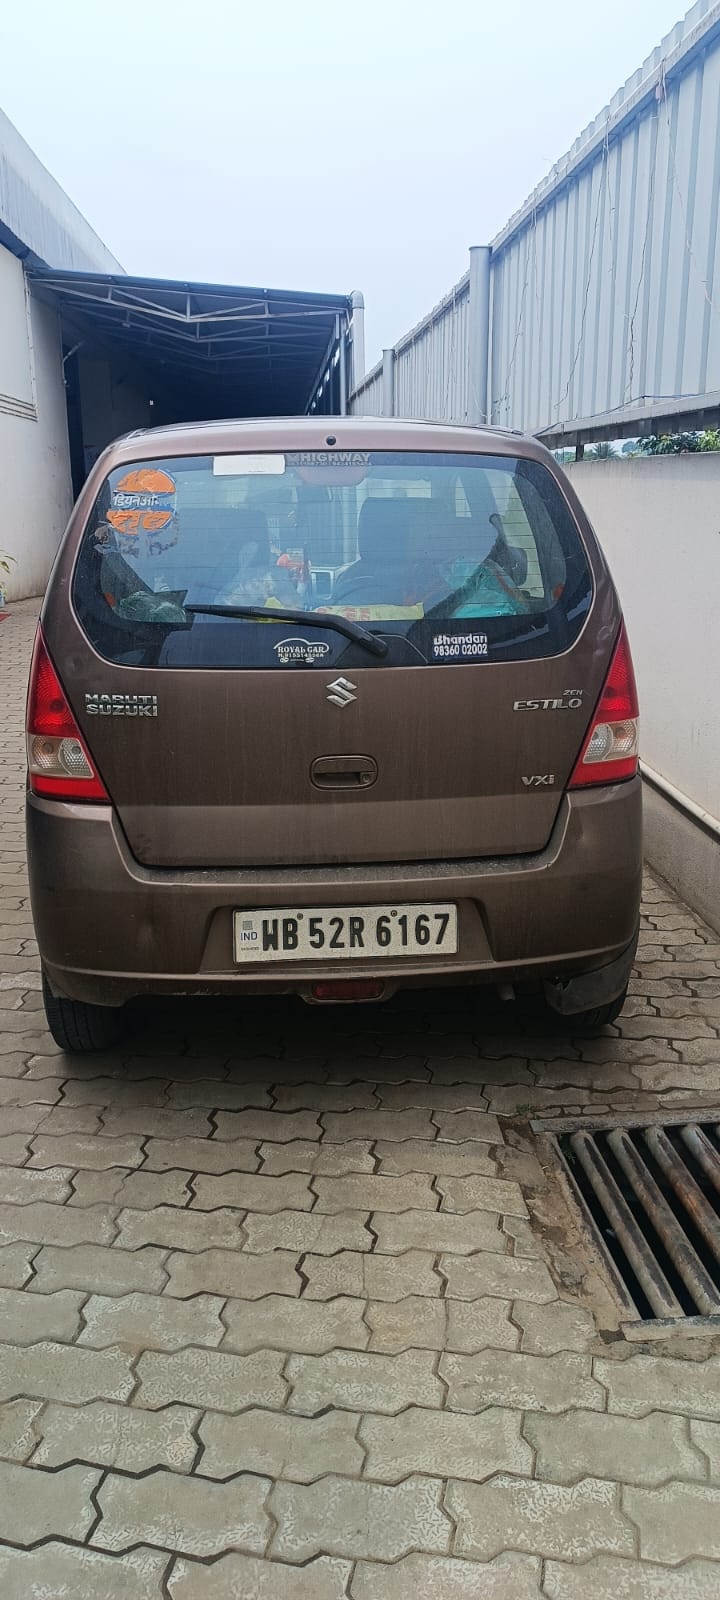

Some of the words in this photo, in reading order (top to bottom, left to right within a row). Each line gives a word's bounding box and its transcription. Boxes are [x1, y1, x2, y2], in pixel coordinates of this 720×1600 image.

[301, 453, 372, 462] HIGHWAY
[433, 645, 460, 656] 98360
[461, 643, 488, 655] 02002
[85, 693, 158, 704] MARUTI
[513, 698, 582, 710] ESTILO
[86, 704, 158, 716] SUZUKI
[521, 774, 555, 785] VXi
[240, 931, 258, 941] IND
[262, 917, 299, 951] WB
[309, 916, 365, 949] 52R
[376, 912, 450, 947] 6167
